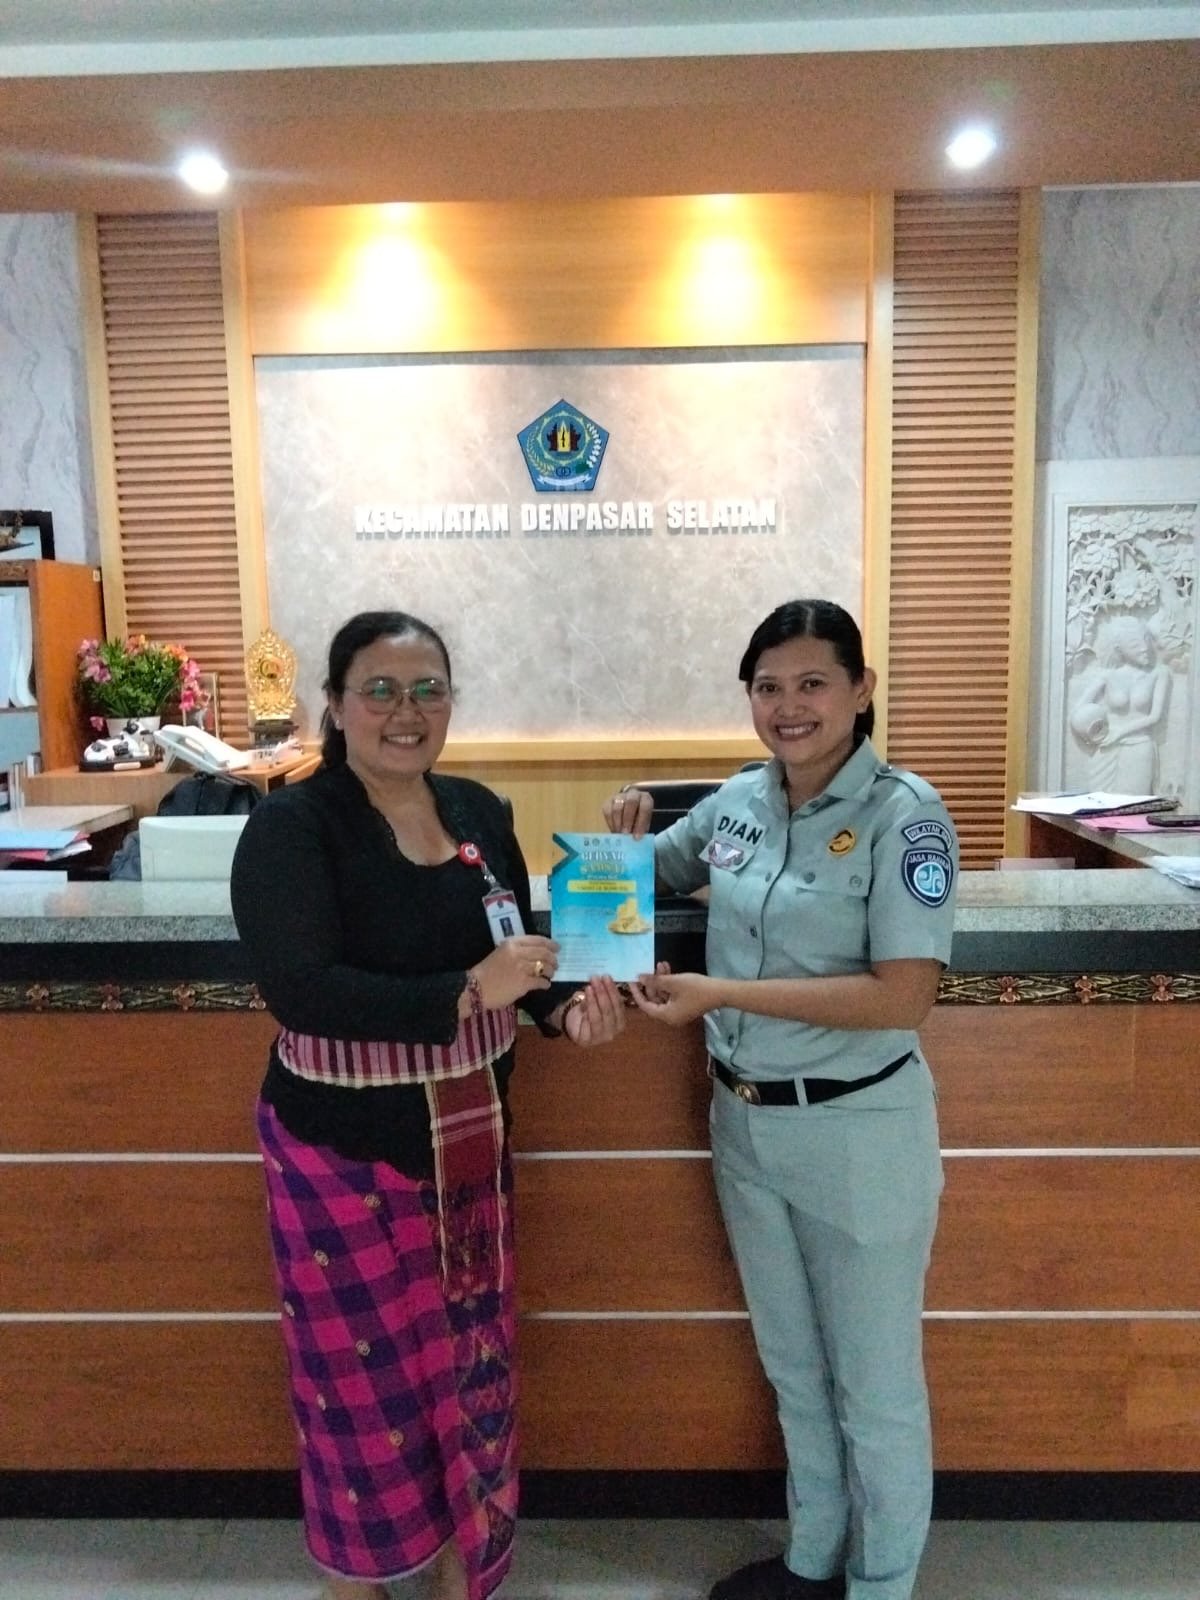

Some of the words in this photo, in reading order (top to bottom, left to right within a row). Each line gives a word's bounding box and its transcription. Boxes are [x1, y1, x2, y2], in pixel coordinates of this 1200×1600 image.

[354, 502, 510, 536] KECAMATAN
[521, 500, 654, 533] DENPASAR
[666, 498, 777, 531] SELATAN
[717, 815, 763, 845] DIAN
[908, 824, 941, 839] WILAYAH
[909, 853, 926, 864] JASA
